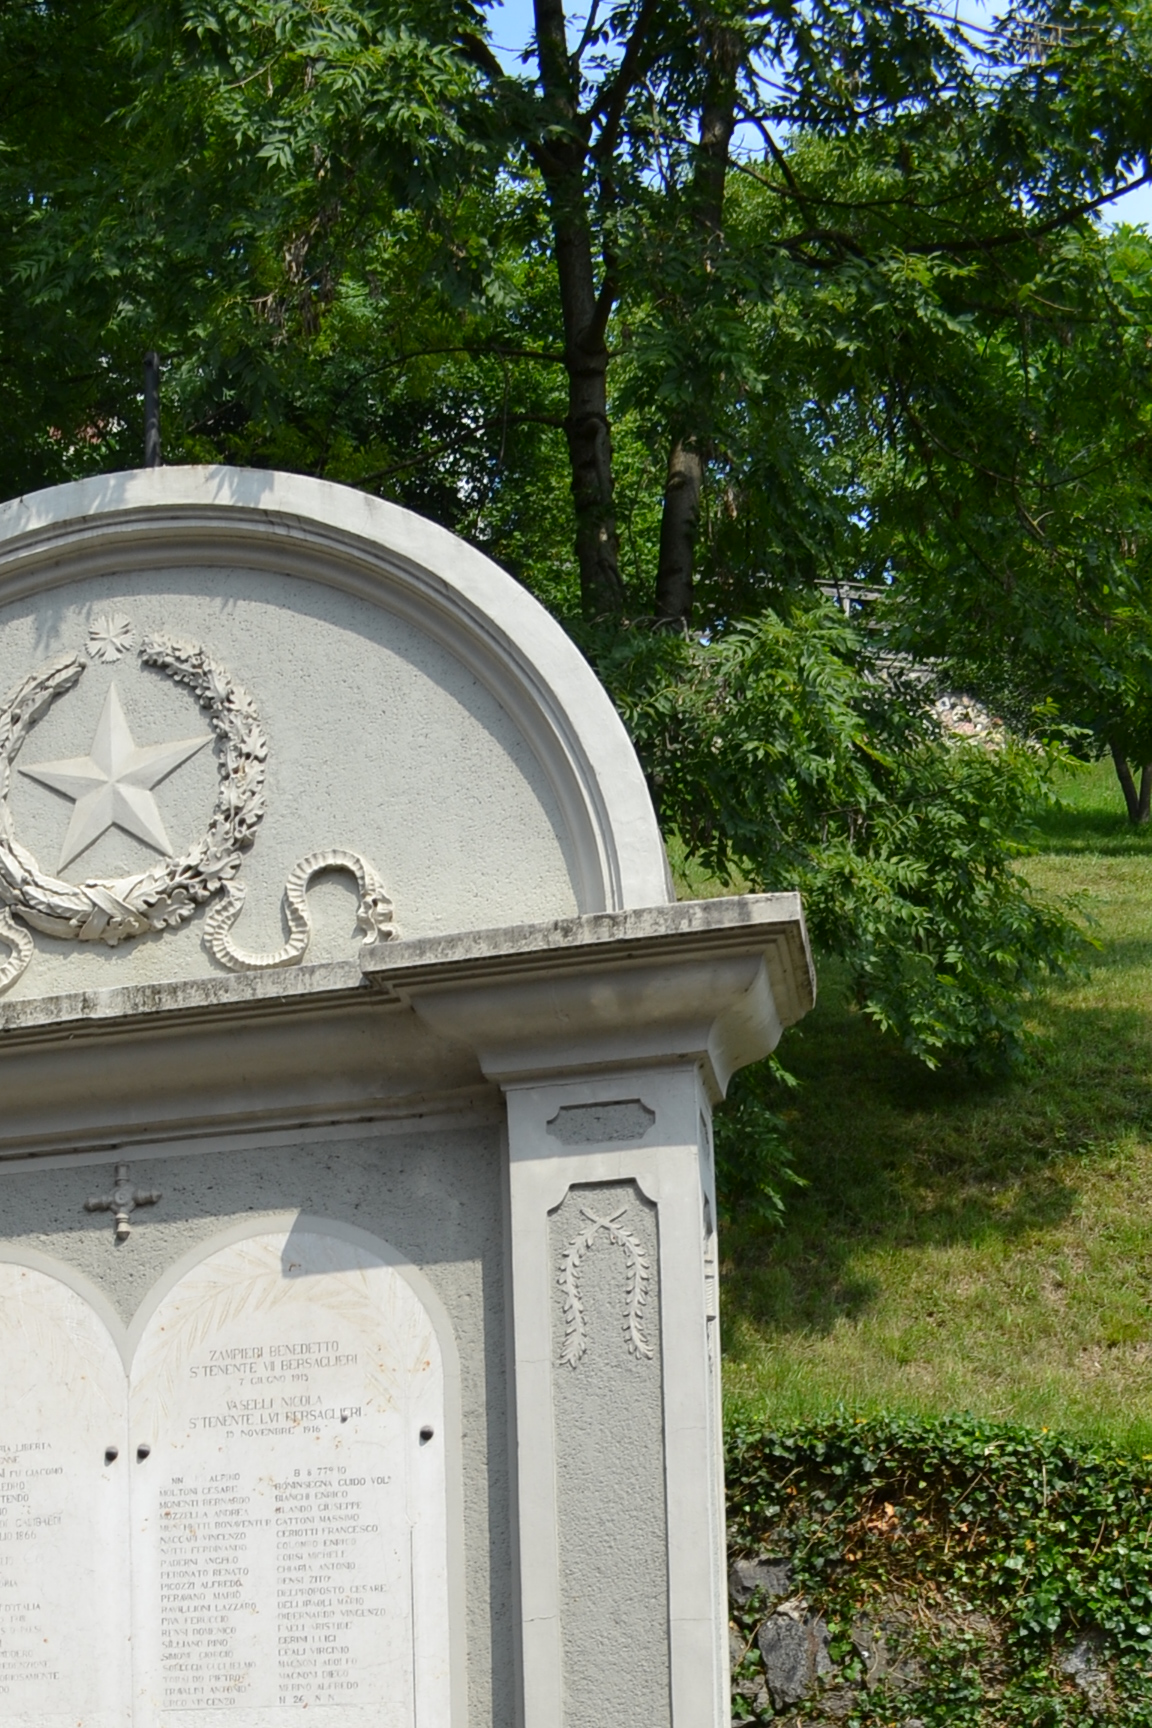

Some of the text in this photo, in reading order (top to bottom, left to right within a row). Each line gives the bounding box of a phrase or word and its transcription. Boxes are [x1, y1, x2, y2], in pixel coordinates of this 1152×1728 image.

[209, 1341, 339, 1362] ZAMPIERI BENEDETTO
[264, 1360, 275, 1372] VII
[281, 1354, 357, 1371] BERSAGLIERI
[239, 1378, 244, 1386] 7
[250, 1375, 286, 1385] GIUGNO
[281, 1395, 322, 1407] NICOLA
[260, 1412, 279, 1424] LVI
[303, 1425, 321, 1433] 1916
[25, 1467, 63, 1477] GIACOMO
[338, 1478, 366, 1486] GUIDO
[202, 1485, 238, 1494] CESARE
[315, 1490, 348, 1500] ENRICO
[318, 1501, 362, 1511] GIUSEPPE
[214, 1508, 249, 1518] ANDREA
[319, 1514, 359, 1523] MASSIMO
[276, 1524, 378, 1538] CERIOTTI FRANCESCO
[16, 1532, 36, 1540] 1866
[202, 1532, 246, 1541] VINCENZO
[323, 1538, 356, 1547] ENRICO
[319, 1562, 356, 1570] ANTONIO
[213, 1568, 249, 1576] RENATO
[161, 1580, 241, 1590] PICOZZI ALFREDO
[350, 1584, 387, 1593] CESARE
[213, 1591, 241, 1600] MARIO
[337, 1597, 364, 1605] MARIO
[215, 1602, 256, 1612] LAZZARO
[340, 1608, 385, 1618] VINCENZO
[193, 1627, 236, 1635] DOMENICO
[310, 1646, 349, 1655] VIRGINIO
[318, 1681, 358, 1690] ALFREDO
